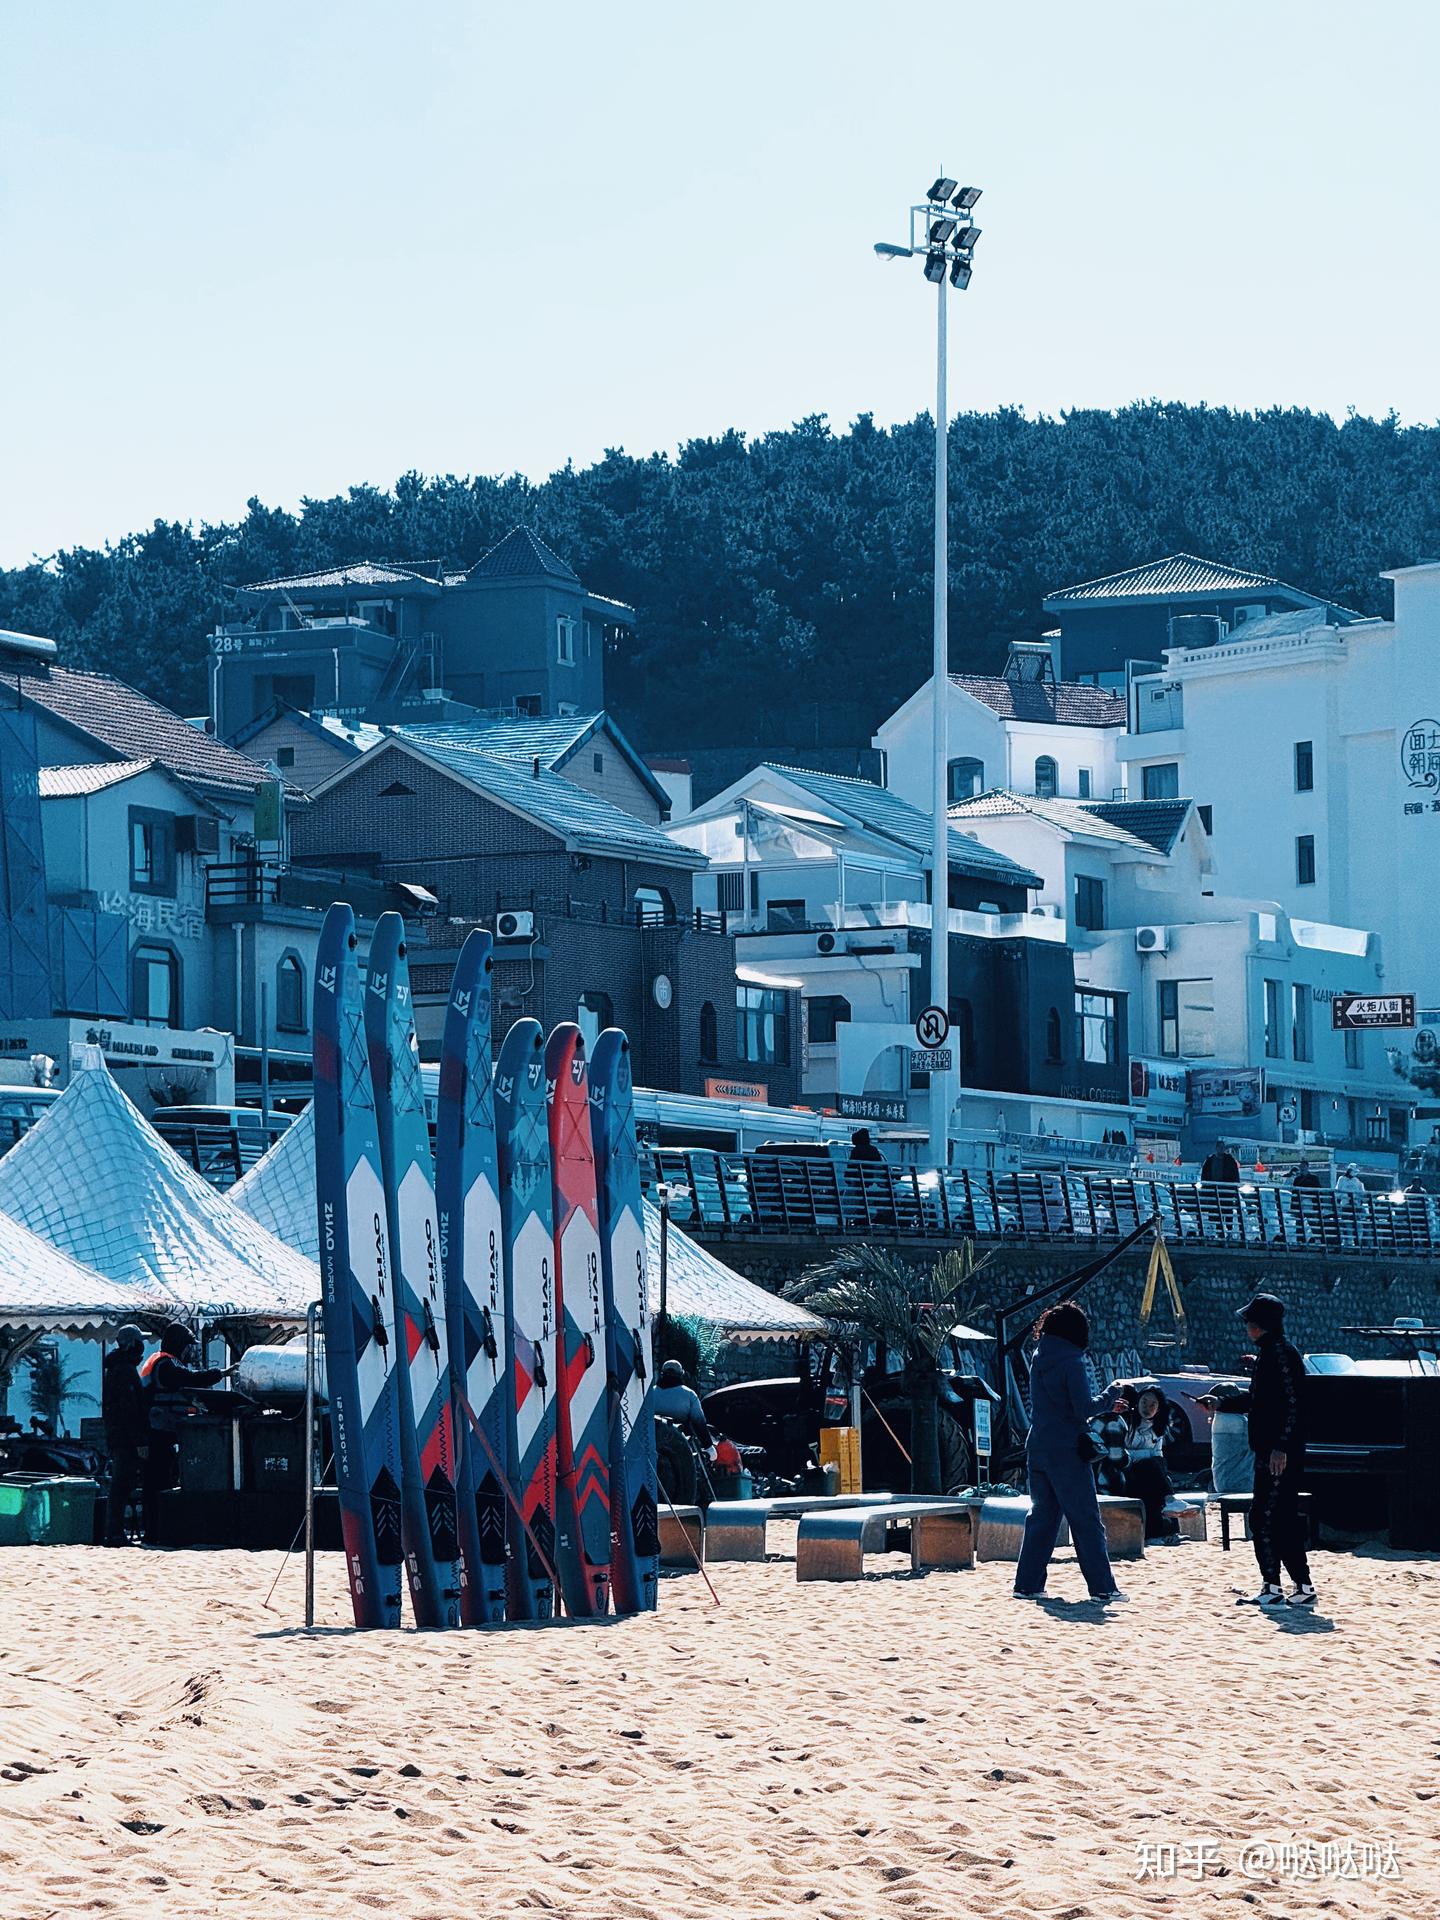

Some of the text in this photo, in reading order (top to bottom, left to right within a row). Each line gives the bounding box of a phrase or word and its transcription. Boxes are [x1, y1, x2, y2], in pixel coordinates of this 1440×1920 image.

[1356, 1001, 1399, 1013] 火炬八街
[324, 1202, 335, 1304] ZHAO MARINE
[373, 1212, 385, 1298] ZHAO
[425, 1218, 437, 1302] ZHAO
[489, 1230, 497, 1311] ZHAO
[591, 1251, 600, 1334] ZHAO
[636, 1250, 645, 1330] ZHAO
